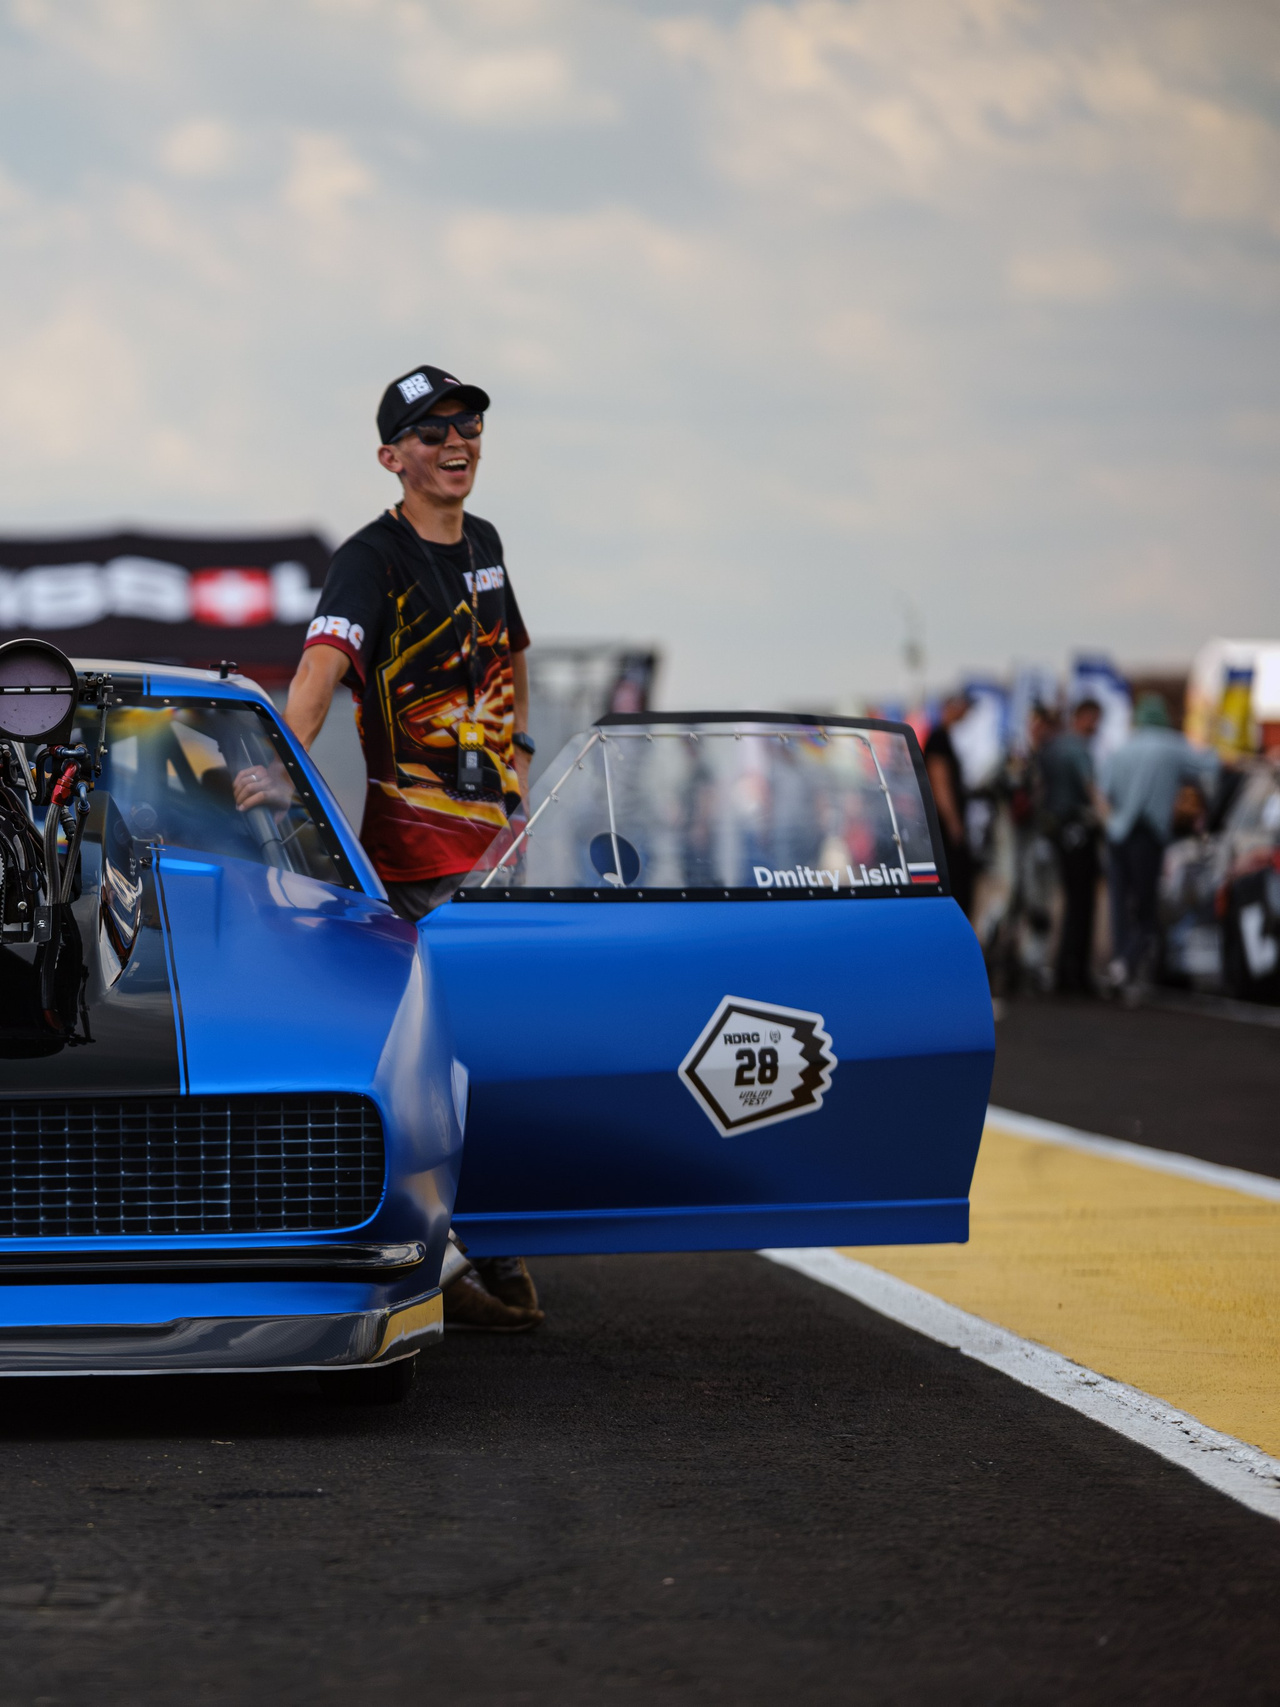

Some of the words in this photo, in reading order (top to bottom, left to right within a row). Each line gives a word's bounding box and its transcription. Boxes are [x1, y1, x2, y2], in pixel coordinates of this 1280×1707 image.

[753, 864, 840, 892] Dmitry
[846, 863, 910, 886] Lisin
[734, 1046, 779, 1087] 28
